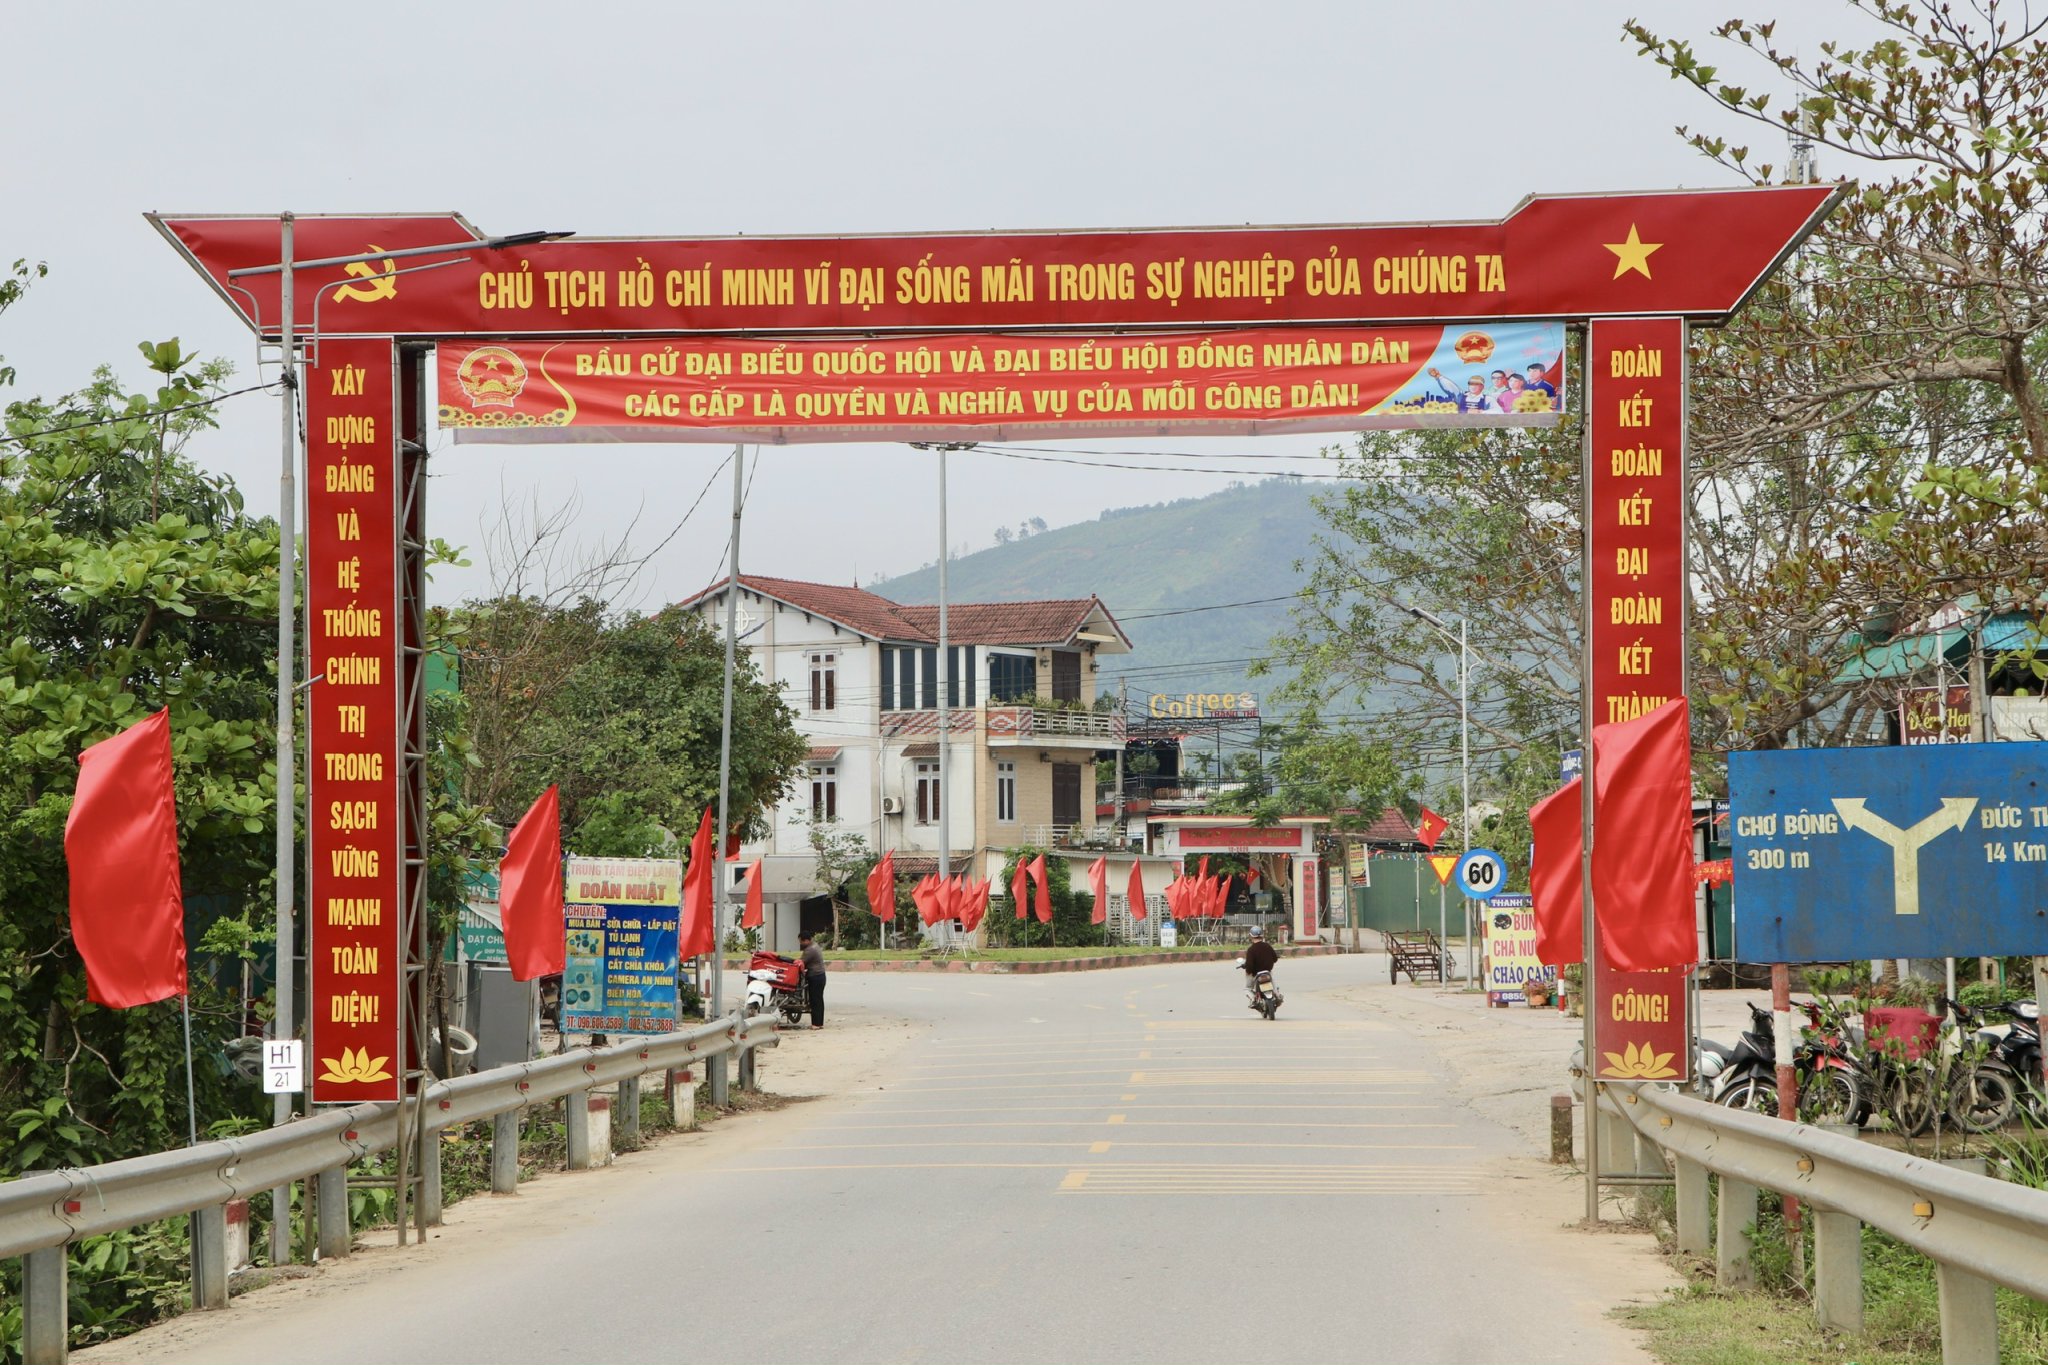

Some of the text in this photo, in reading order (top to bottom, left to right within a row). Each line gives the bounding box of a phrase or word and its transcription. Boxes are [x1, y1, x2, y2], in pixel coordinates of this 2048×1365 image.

[479, 246, 1507, 314] CHỦ TỊCH HỒ CHÍ MINH VĨ ĐẠI SỐNG MÃI TRONG SỰ NGHIỆP CỦA CHÚNG TA
[576, 336, 1410, 382] BẦU CỬ ĐẠI BIỂU QUỐC HỘI VÀ ĐẠI BIỂU HỘI ĐỒNG NHÂN DÂN
[1610, 344, 1662, 378] ĐOÀN
[331, 364, 366, 396] XÂY
[623, 379, 1361, 418] CÁC CẤP LÀ QUYỀN VÀ NGHĨA VỤ CỦA MỖI CÔNG DÂN!
[1618, 389, 1653, 427] KẾT
[326, 414, 375, 450] DỰNG
[325, 456, 375, 493] ĐẢNG
[1611, 442, 1662, 477] ĐOÀN
[1618, 488, 1652, 526] KẾT
[336, 508, 361, 541] VÀ
[337, 557, 360, 593] HỆ
[1616, 548, 1649, 581] ĐẠI
[323, 600, 381, 637] THỐNG
[1610, 591, 1662, 625] ĐOÀN
[326, 652, 381, 686] CHÍNH
[1618, 637, 1653, 675] KẾT
[337, 705, 366, 738] TRỊ
[1150, 693, 1236, 719] Coffee
[324, 753, 383, 782] TRONG
[330, 801, 377, 834] SẠCH
[1737, 808, 1839, 841] CHỢ BỘNG
[1981, 801, 2023, 829] ĐỨC
[331, 845, 379, 878] VỮNG
[1747, 849, 1810, 870] 300 m
[1983, 841, 2047, 863] 14 Km
[1468, 862, 1494, 885] 60
[625, 882, 667, 903] NHẬT
[1491, 899, 1523, 907] THANH
[327, 898, 381, 931] MẠNH
[608, 929, 641, 945] TỦ LẠNH
[608, 945, 645, 959] MÁY GIẶT
[332, 942, 378, 975] TOÀN
[644, 961, 665, 972] KHÓA
[1493, 961, 1524, 984] CHÁO
[607, 975, 674, 987] CAMERA AN NINH
[331, 991, 379, 1027] DIỆN!
[1611, 988, 1669, 1023] CÔNG!
[270, 1045, 293, 1066] H1
[274, 1071, 290, 1088] 21
